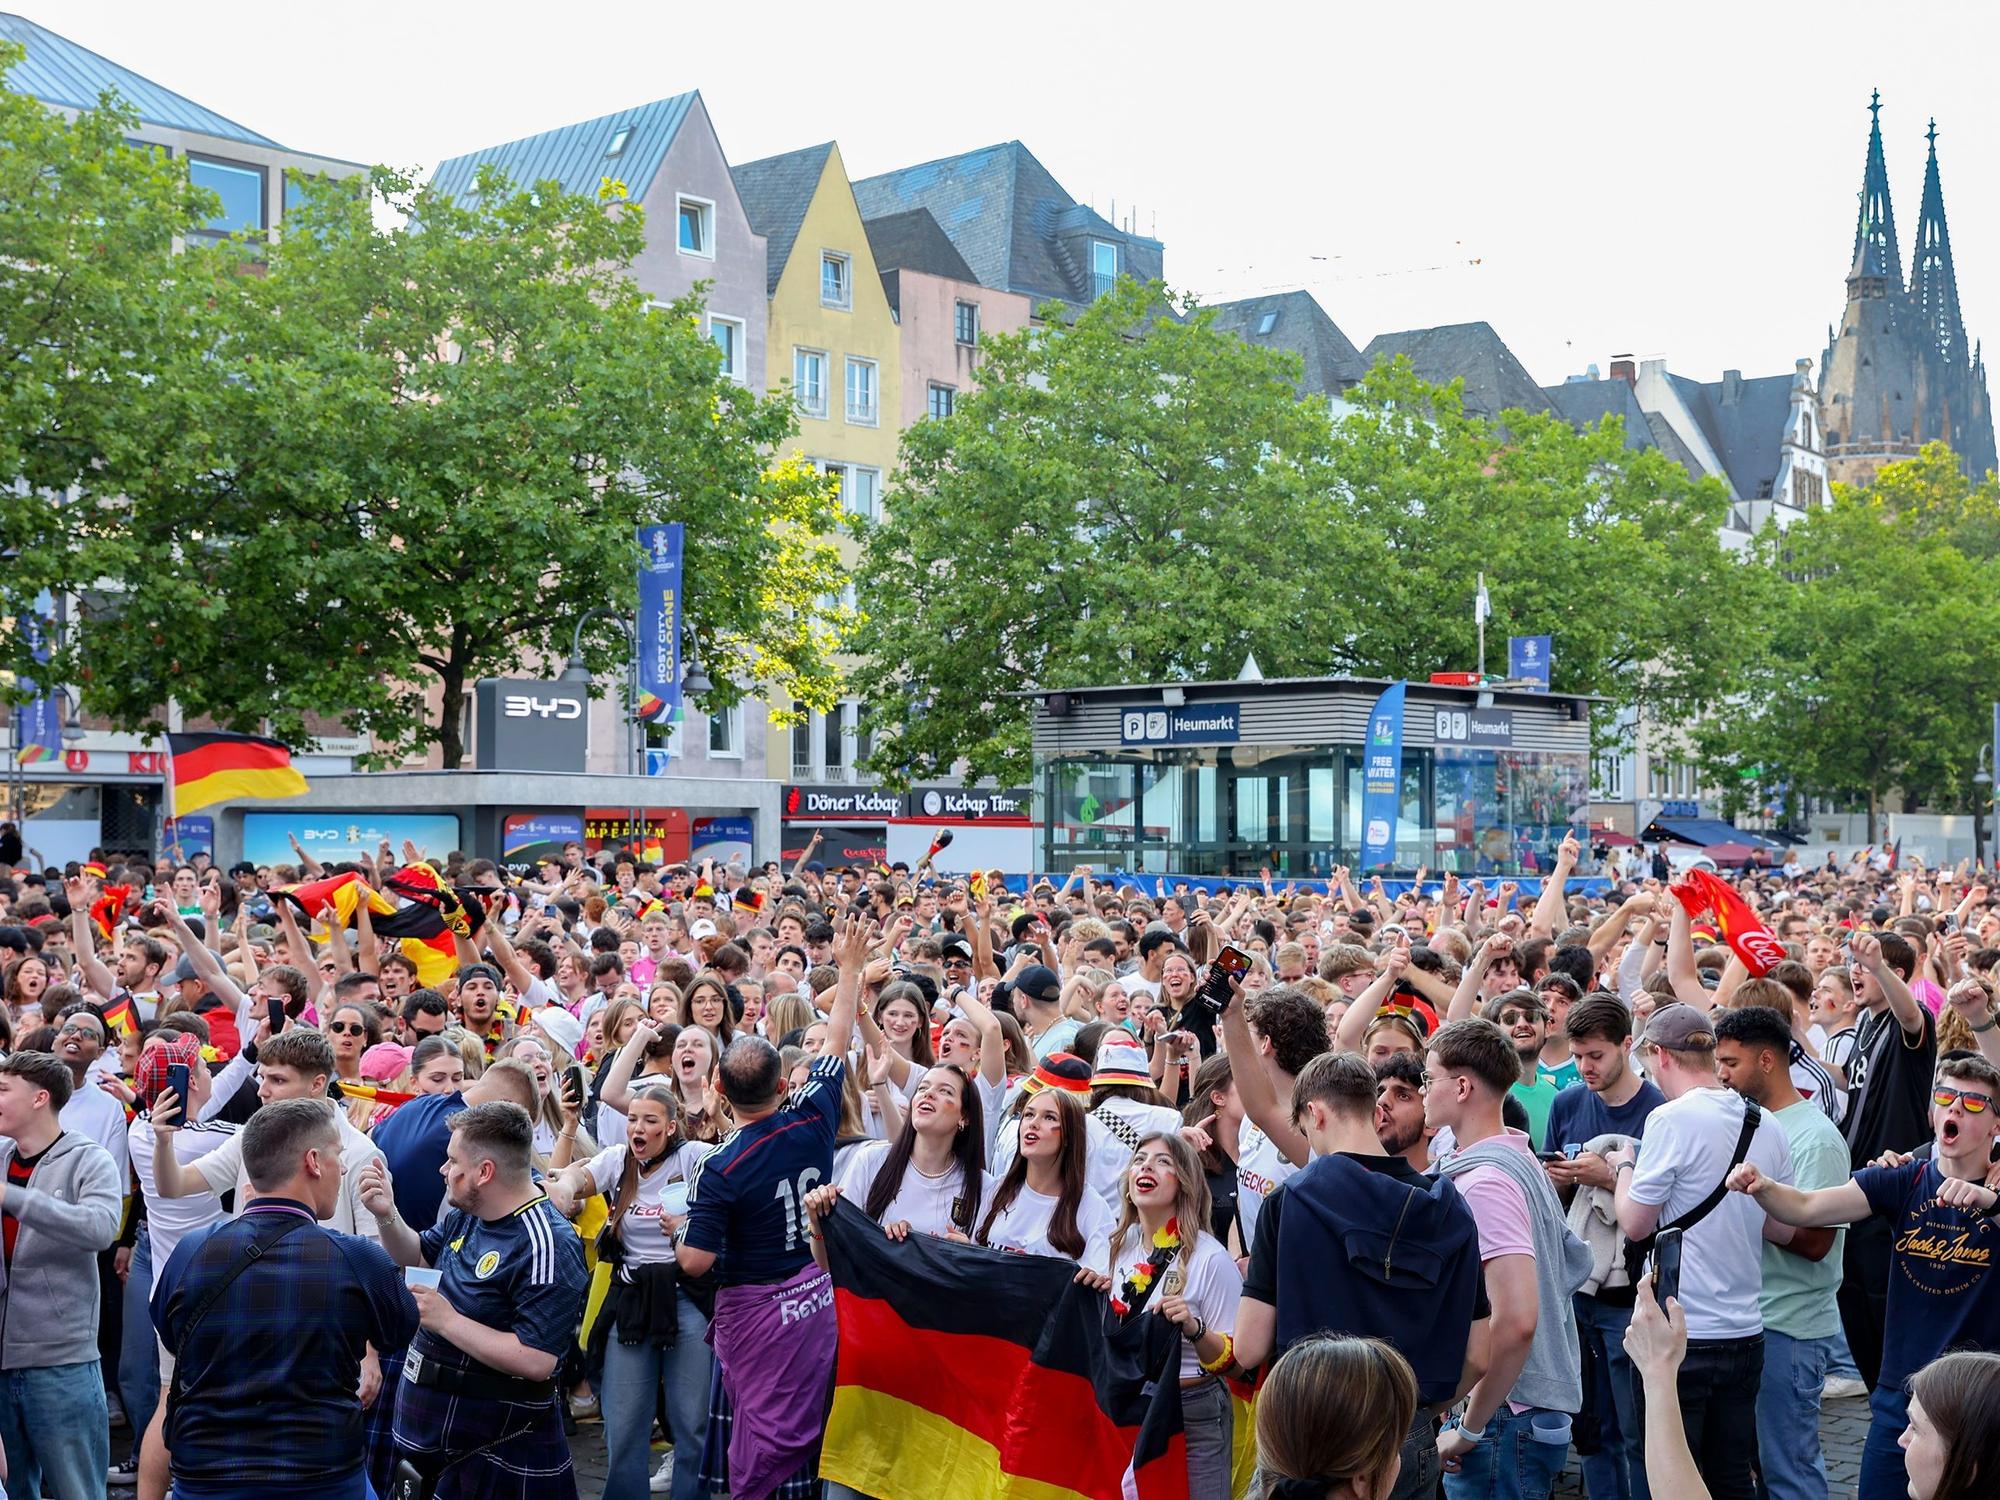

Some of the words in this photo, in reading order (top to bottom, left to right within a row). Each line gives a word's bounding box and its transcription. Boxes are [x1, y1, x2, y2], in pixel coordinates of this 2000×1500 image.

[657, 610, 666, 643] CITY
[663, 589, 674, 683] COLOGNE
[657, 645, 666, 684] HOST
[505, 695, 582, 719] BYD
[1174, 715, 1235, 732] Heumarkt
[1471, 720, 1510, 735] Heumarkt
[1372, 756, 1393, 767] FREE
[1367, 767, 1396, 779] WATER
[807, 793, 853, 812] Döner
[854, 792, 902, 817] Kebap
[989, 794, 1021, 812] Tim
[303, 829, 340, 840] BYD
[1848, 1055, 1868, 1090] 18
[1237, 1165, 1276, 1196] HECK2
[1910, 1198, 1991, 1235] AUTNTIC
[1929, 1262, 1946, 1271] 1990
[1944, 1282, 1970, 1295] DENIM
